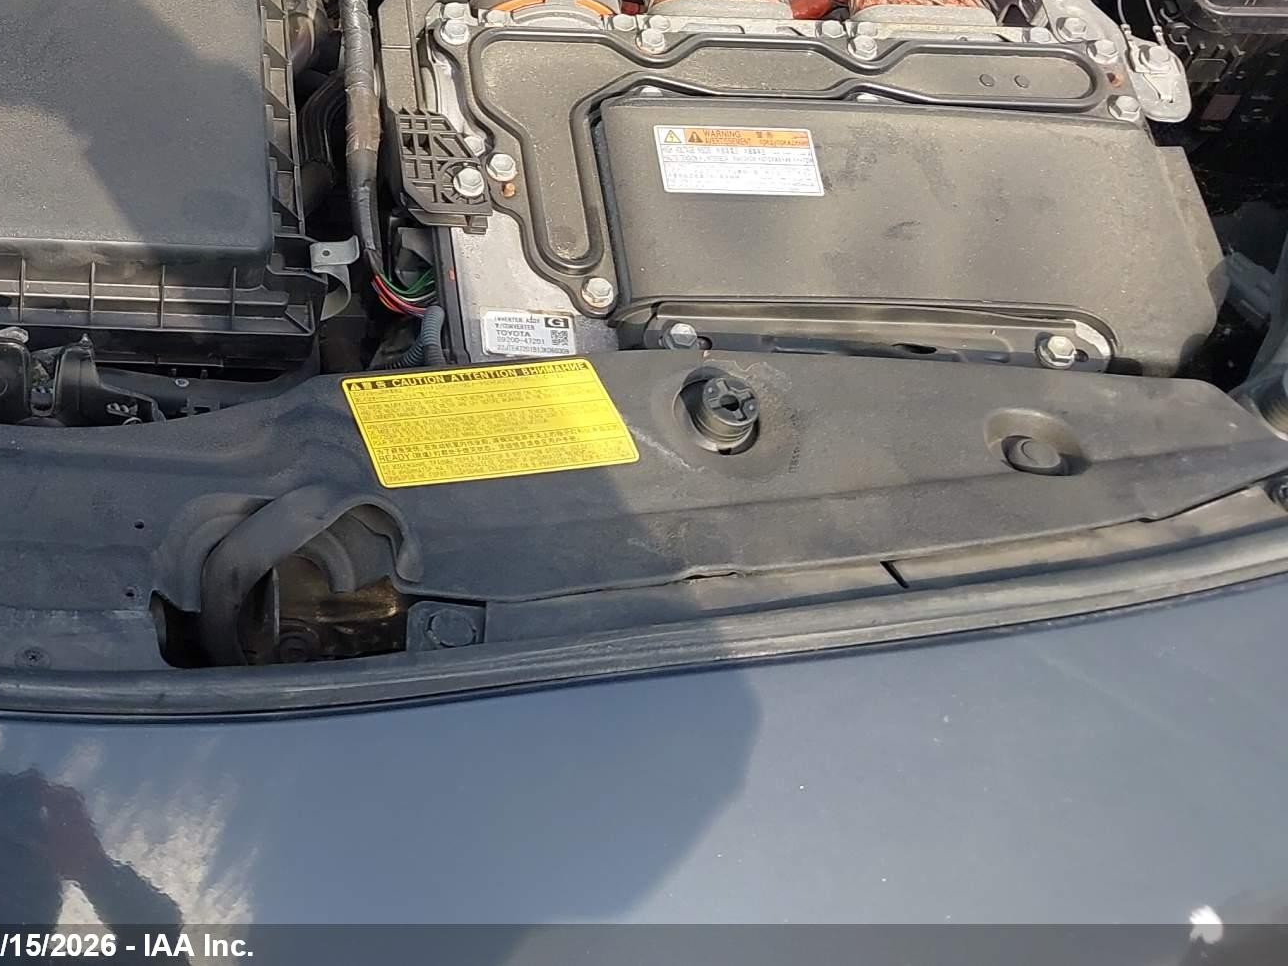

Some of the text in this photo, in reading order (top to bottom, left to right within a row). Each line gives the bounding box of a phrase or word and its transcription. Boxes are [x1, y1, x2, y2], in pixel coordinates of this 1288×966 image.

[703, 129, 741, 138] WARNING
[496, 329, 531, 337] TOYOTA
[392, 374, 446, 387] CAUTION
[451, 368, 518, 382] ATTENTION
